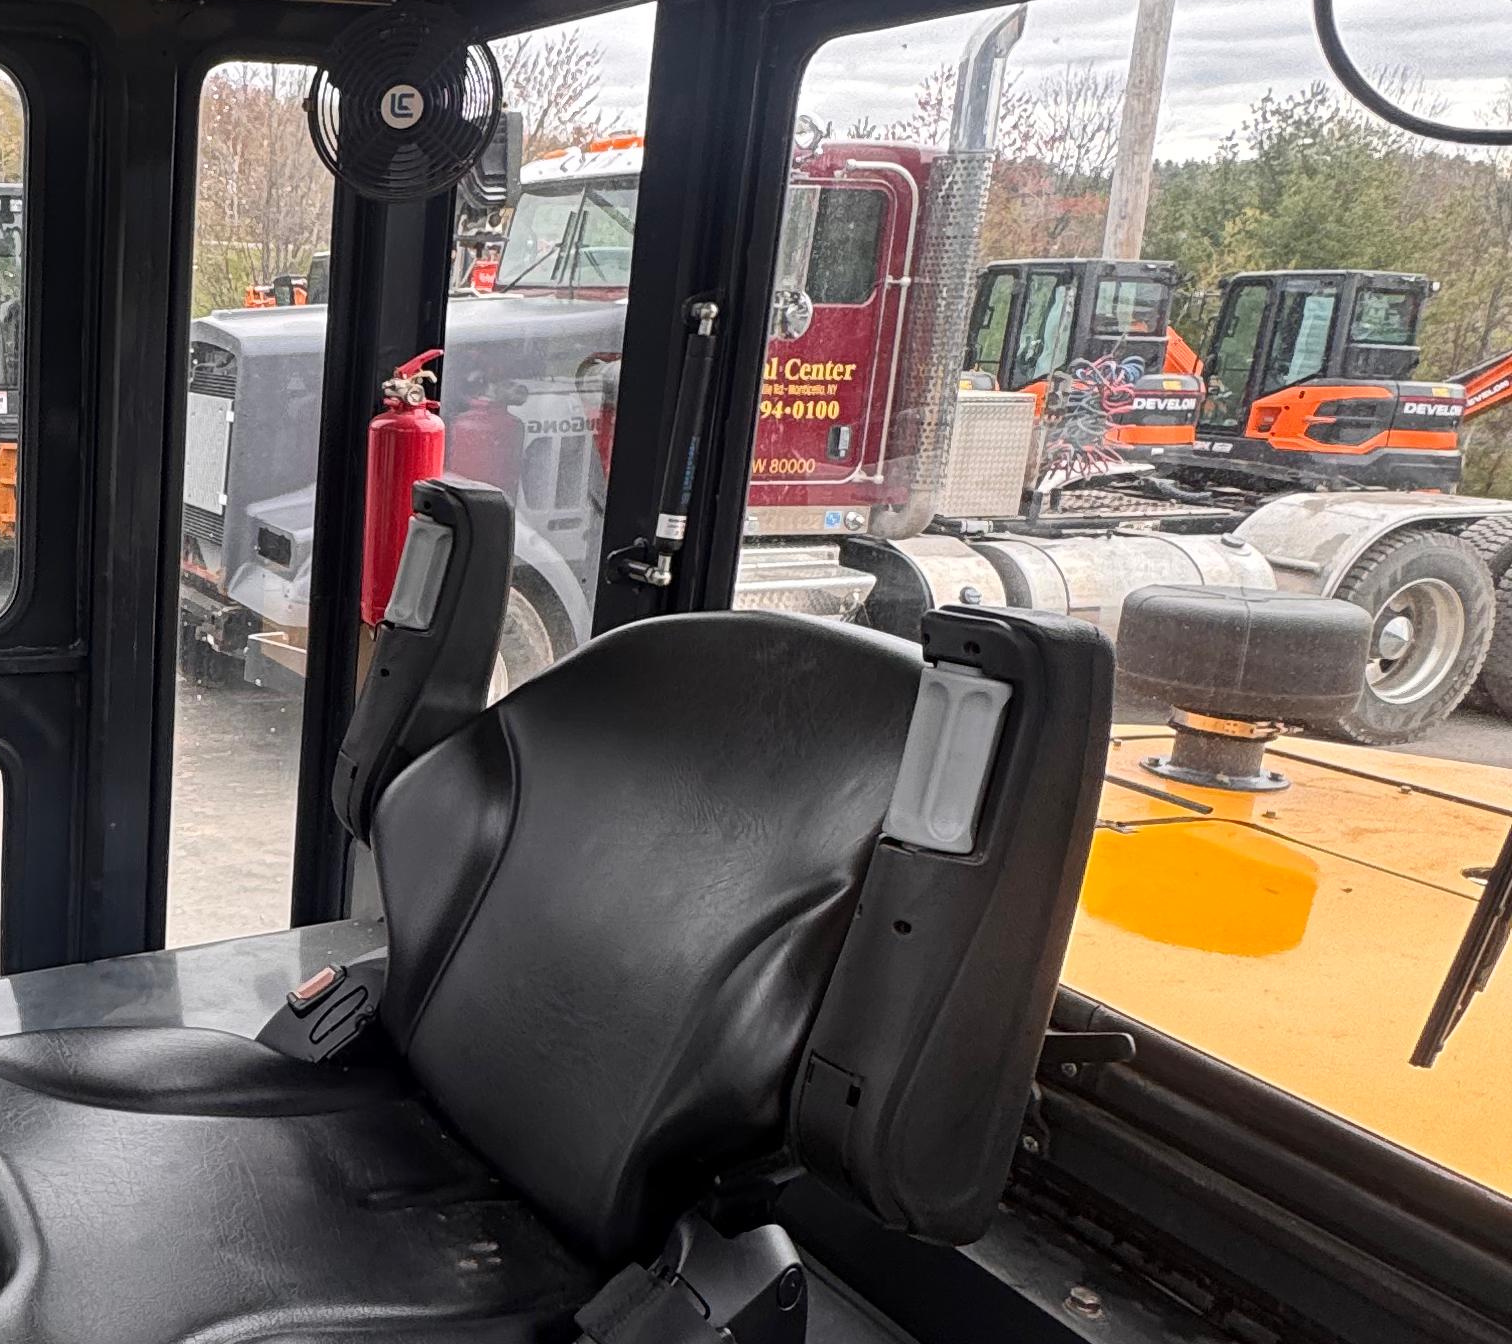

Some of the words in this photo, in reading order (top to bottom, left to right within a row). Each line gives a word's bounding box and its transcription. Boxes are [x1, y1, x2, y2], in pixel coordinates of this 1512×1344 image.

[784, 358, 857, 381] Center
[1467, 379, 1510, 406] EVELON
[1133, 398, 1197, 411] DEVELON
[1403, 402, 1464, 416] DEVELON
[769, 458, 816, 473] 80000
